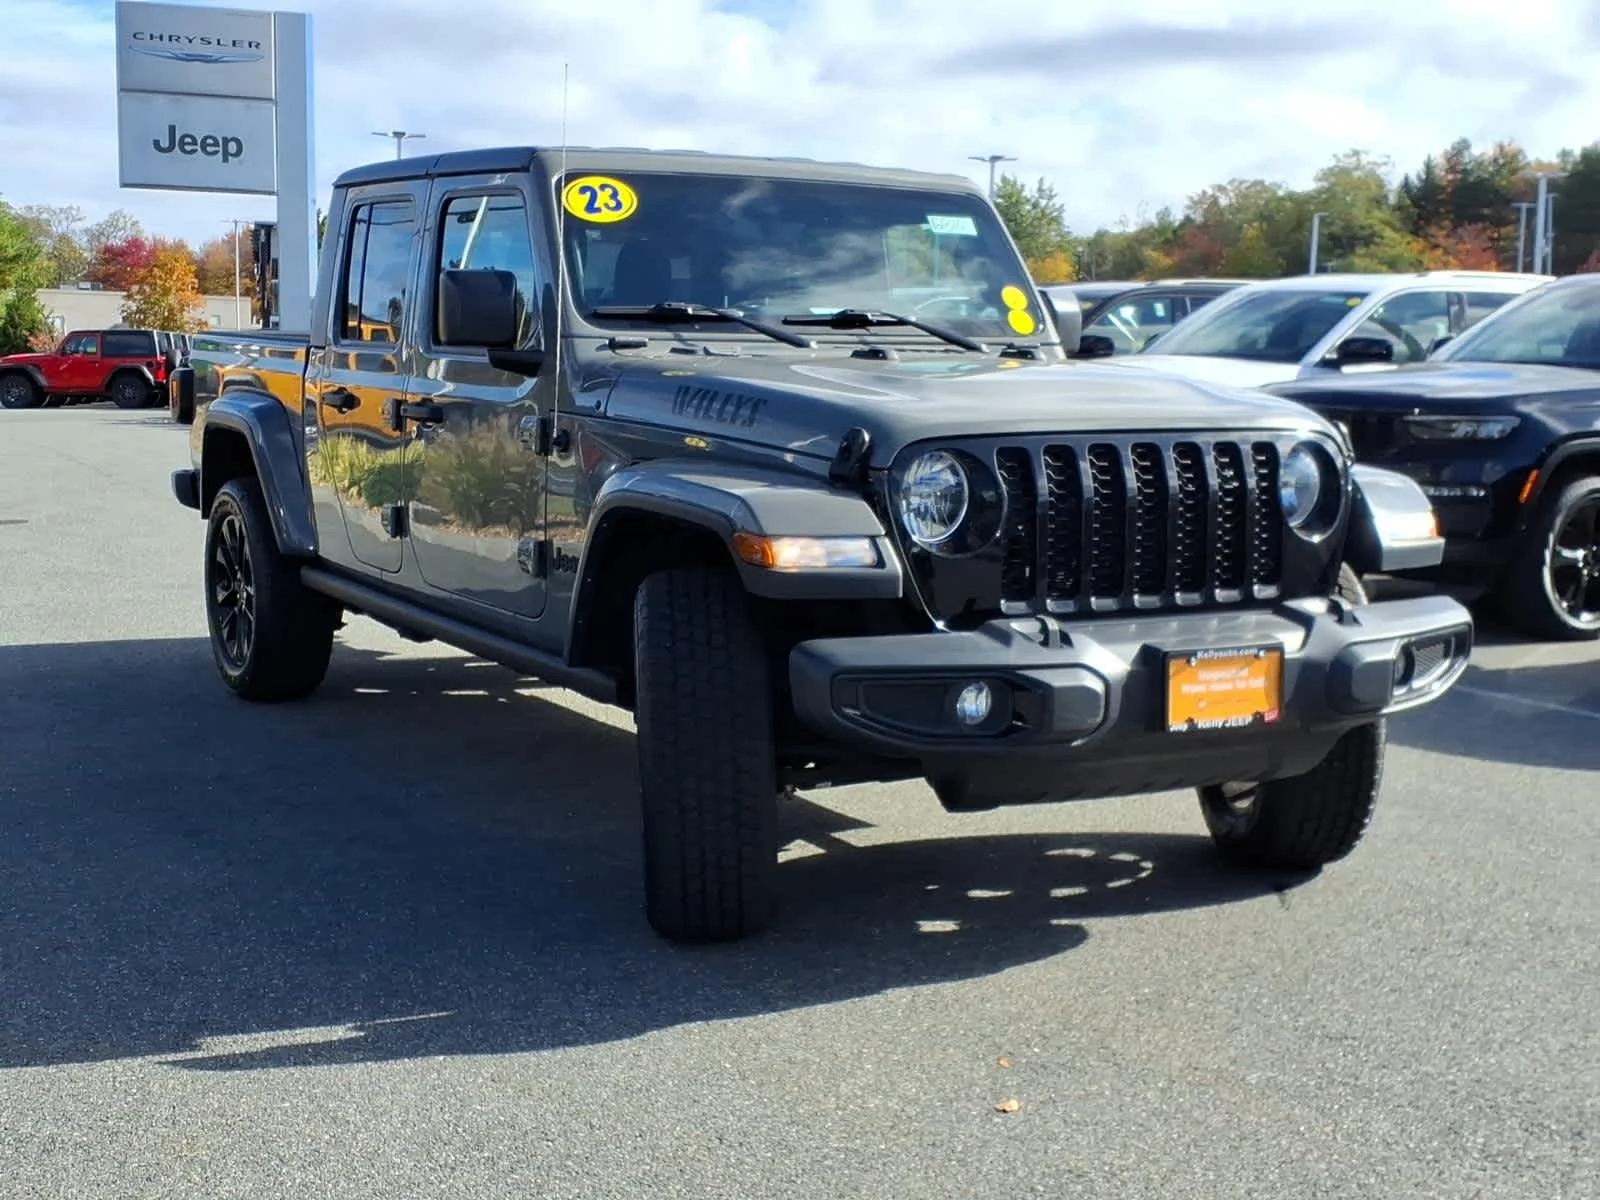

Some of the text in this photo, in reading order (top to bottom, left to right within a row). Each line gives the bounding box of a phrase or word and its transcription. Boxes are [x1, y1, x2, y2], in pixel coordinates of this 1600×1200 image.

[132, 31, 262, 49] CHRYSLER
[152, 124, 244, 163] Jeep
[578, 183, 623, 214] 23
[672, 385, 768, 427] WILLYS
